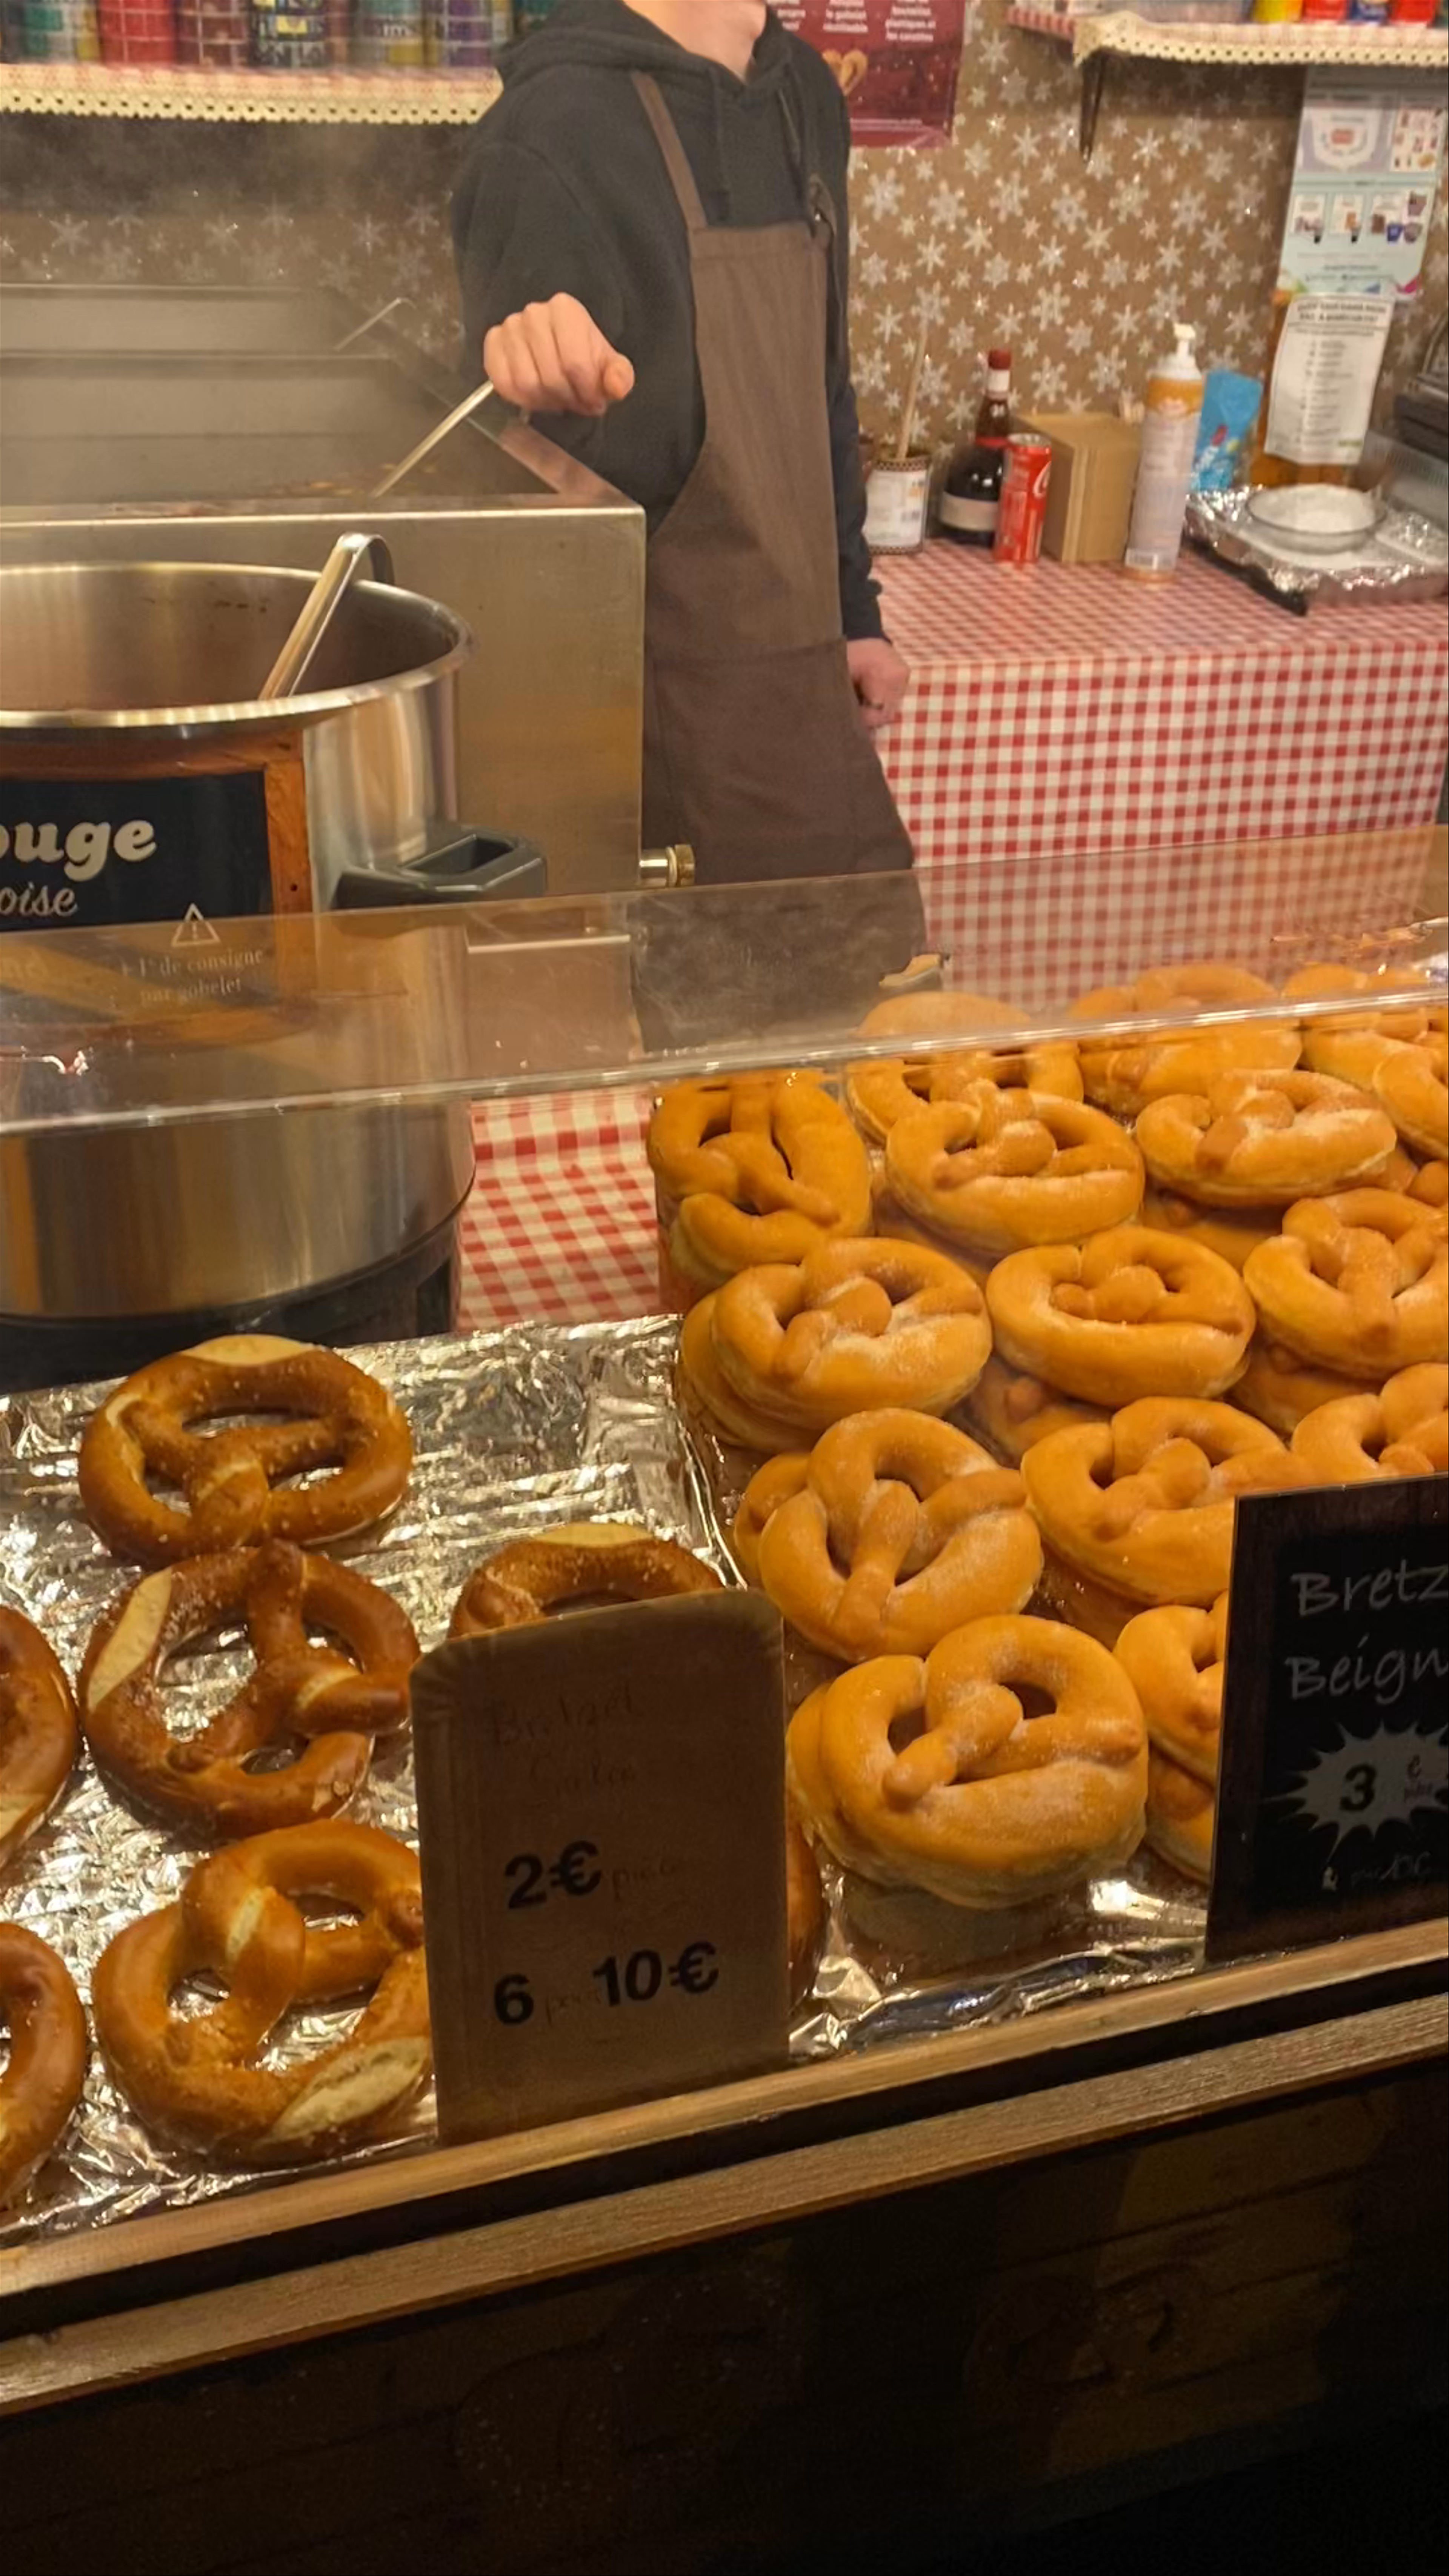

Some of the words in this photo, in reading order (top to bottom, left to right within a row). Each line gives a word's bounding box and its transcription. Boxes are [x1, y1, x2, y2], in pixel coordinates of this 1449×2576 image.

[187, 949, 263, 975] consigne
[1340, 1762, 1377, 1812] 3
[494, 1973, 534, 2026] 6
[592, 1941, 720, 2007] 10€
